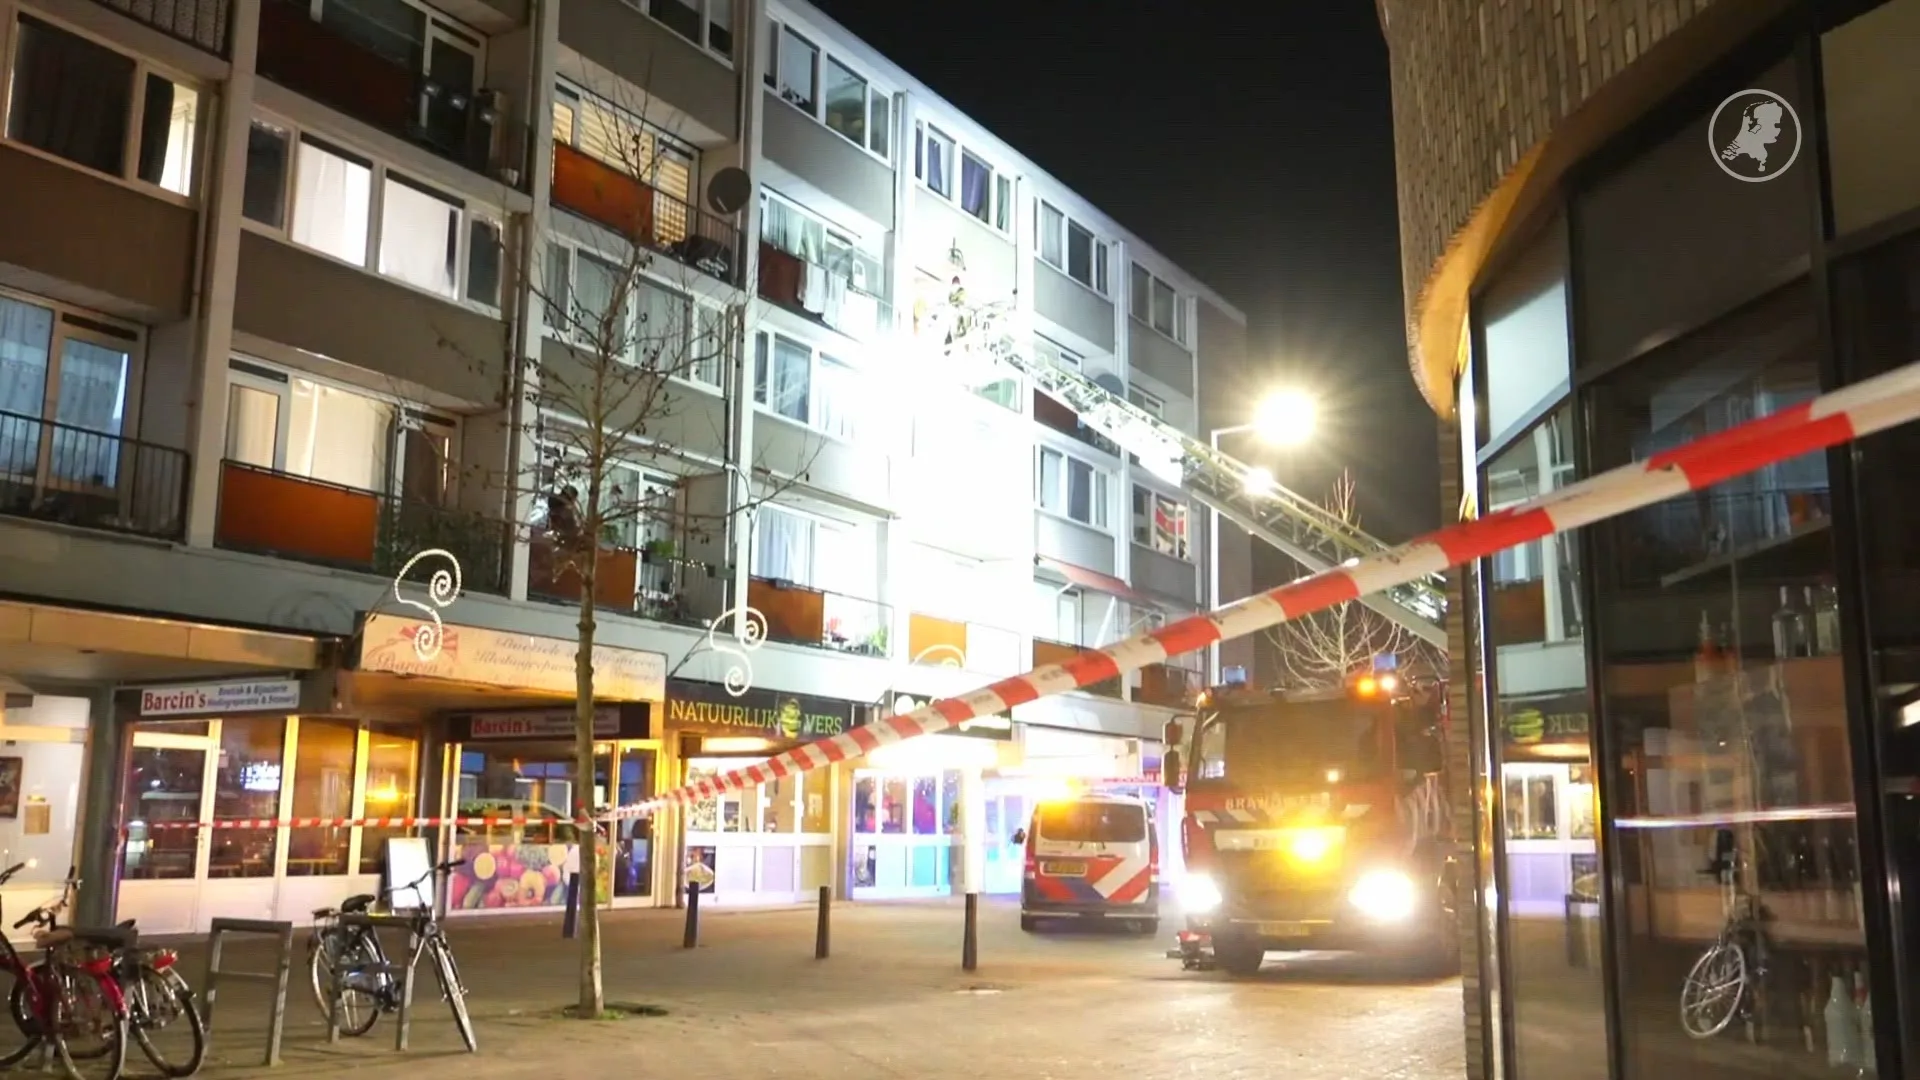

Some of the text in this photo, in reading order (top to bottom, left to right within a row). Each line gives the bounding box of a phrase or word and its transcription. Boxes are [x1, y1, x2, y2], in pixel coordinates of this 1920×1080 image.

[377, 651, 455, 676] Barcins
[143, 688, 206, 711] Barcin's
[473, 717, 532, 734] Barcin's
[670, 699, 843, 735] NATUURLIJK VERS
